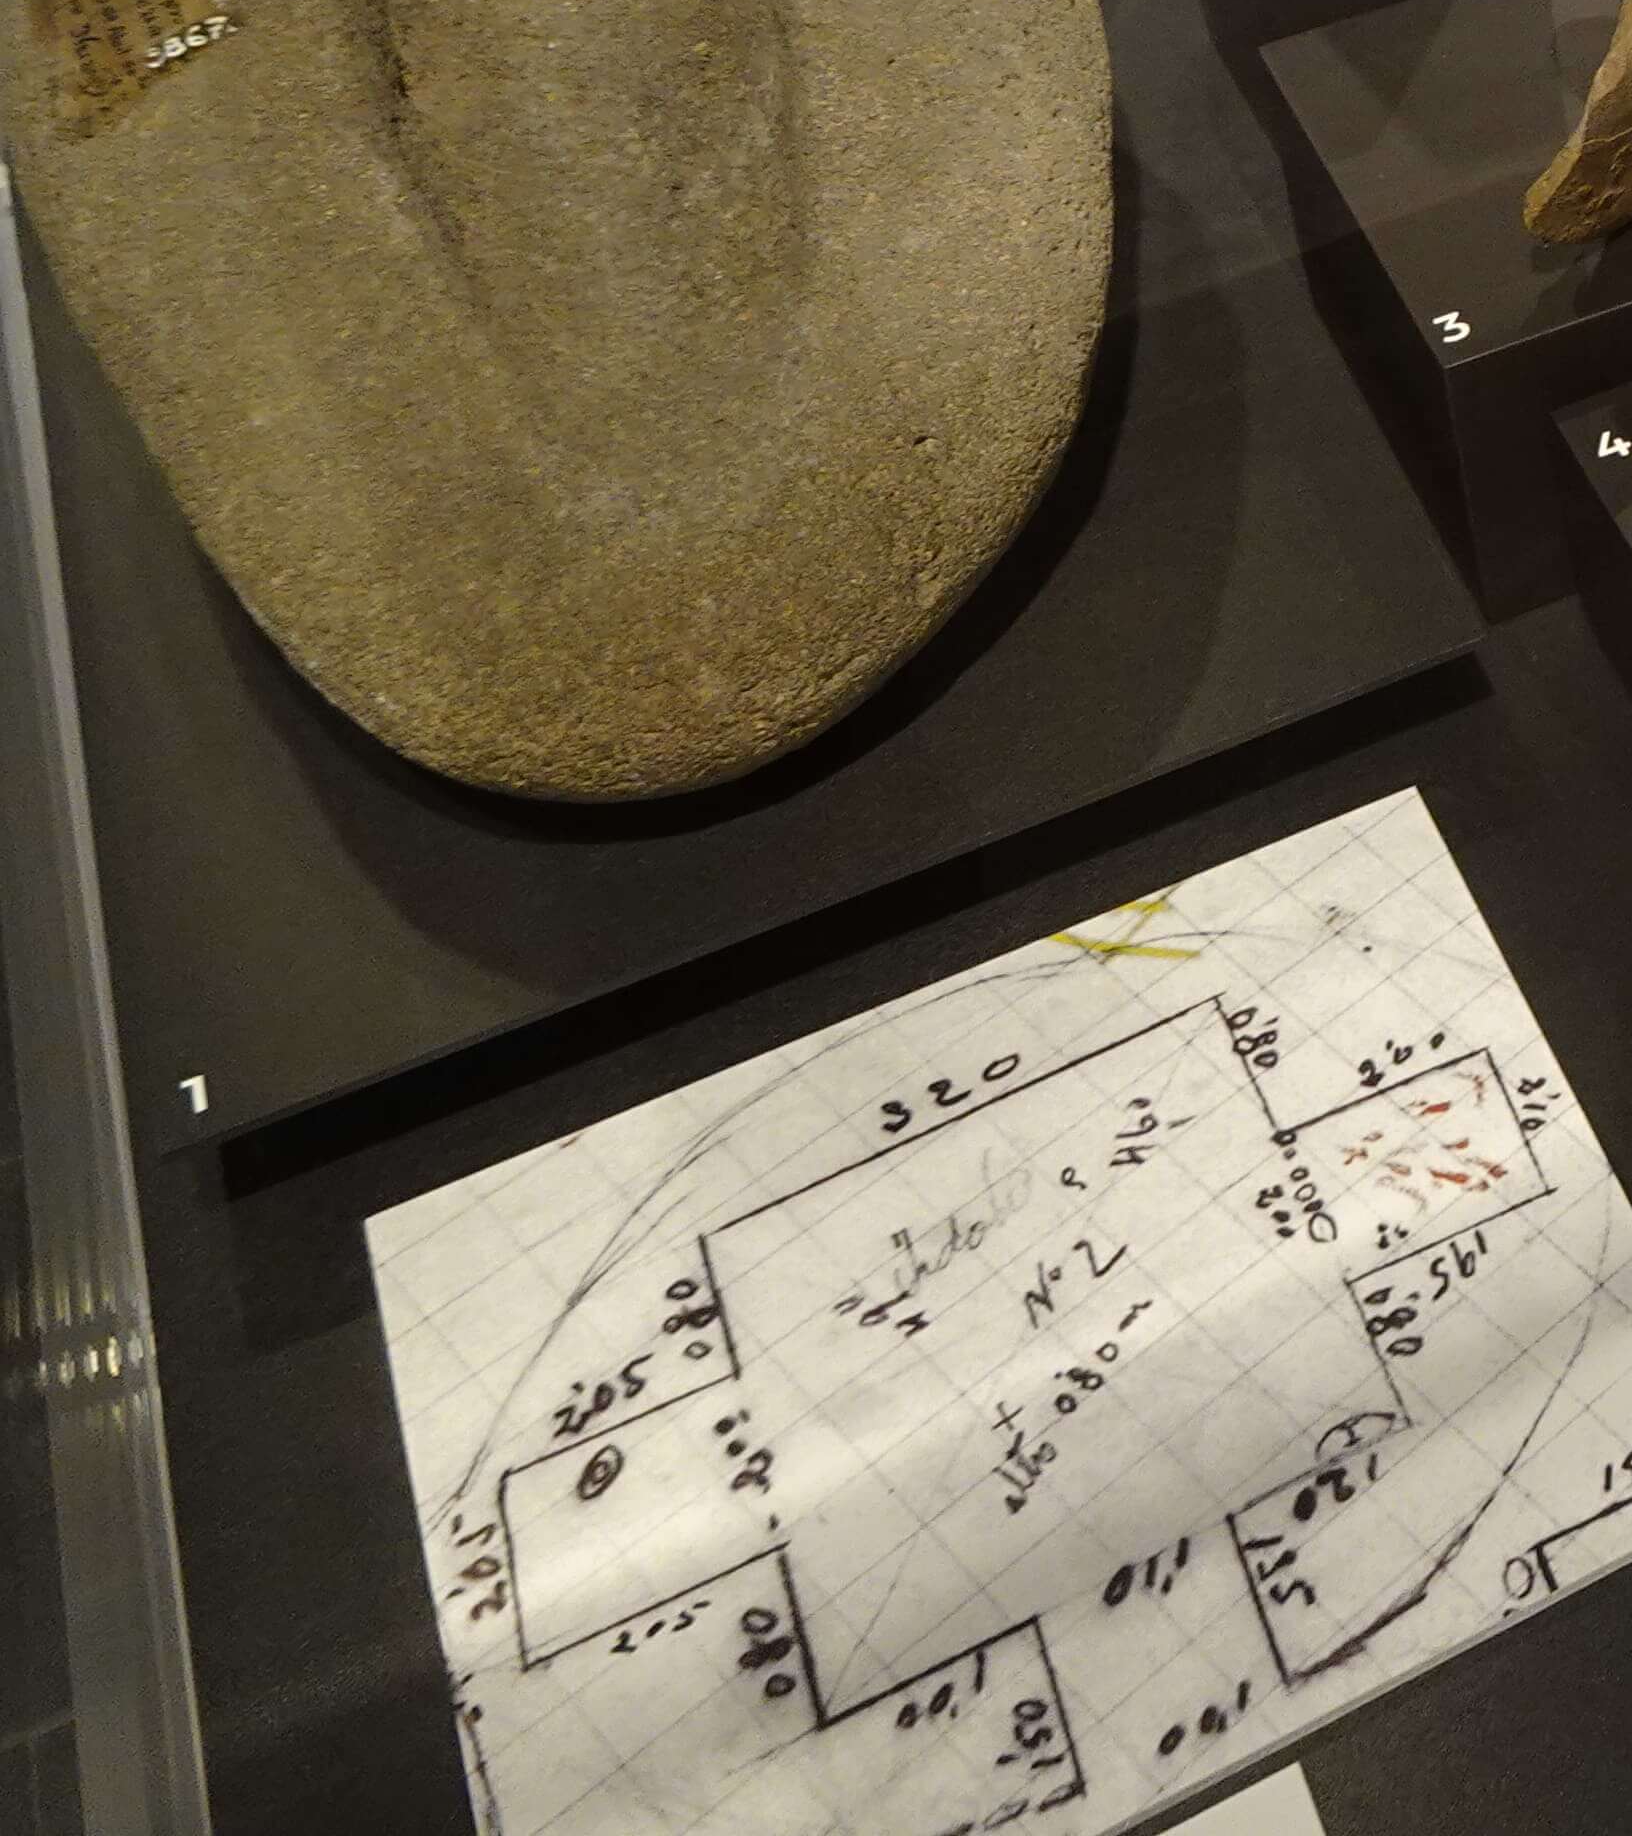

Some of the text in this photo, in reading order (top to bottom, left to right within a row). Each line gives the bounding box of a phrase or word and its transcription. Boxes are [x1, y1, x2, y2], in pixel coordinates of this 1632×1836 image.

[1431, 310, 1472, 344] 3
[1597, 430, 1632, 459] 4
[178, 1073, 209, 1114] 1
